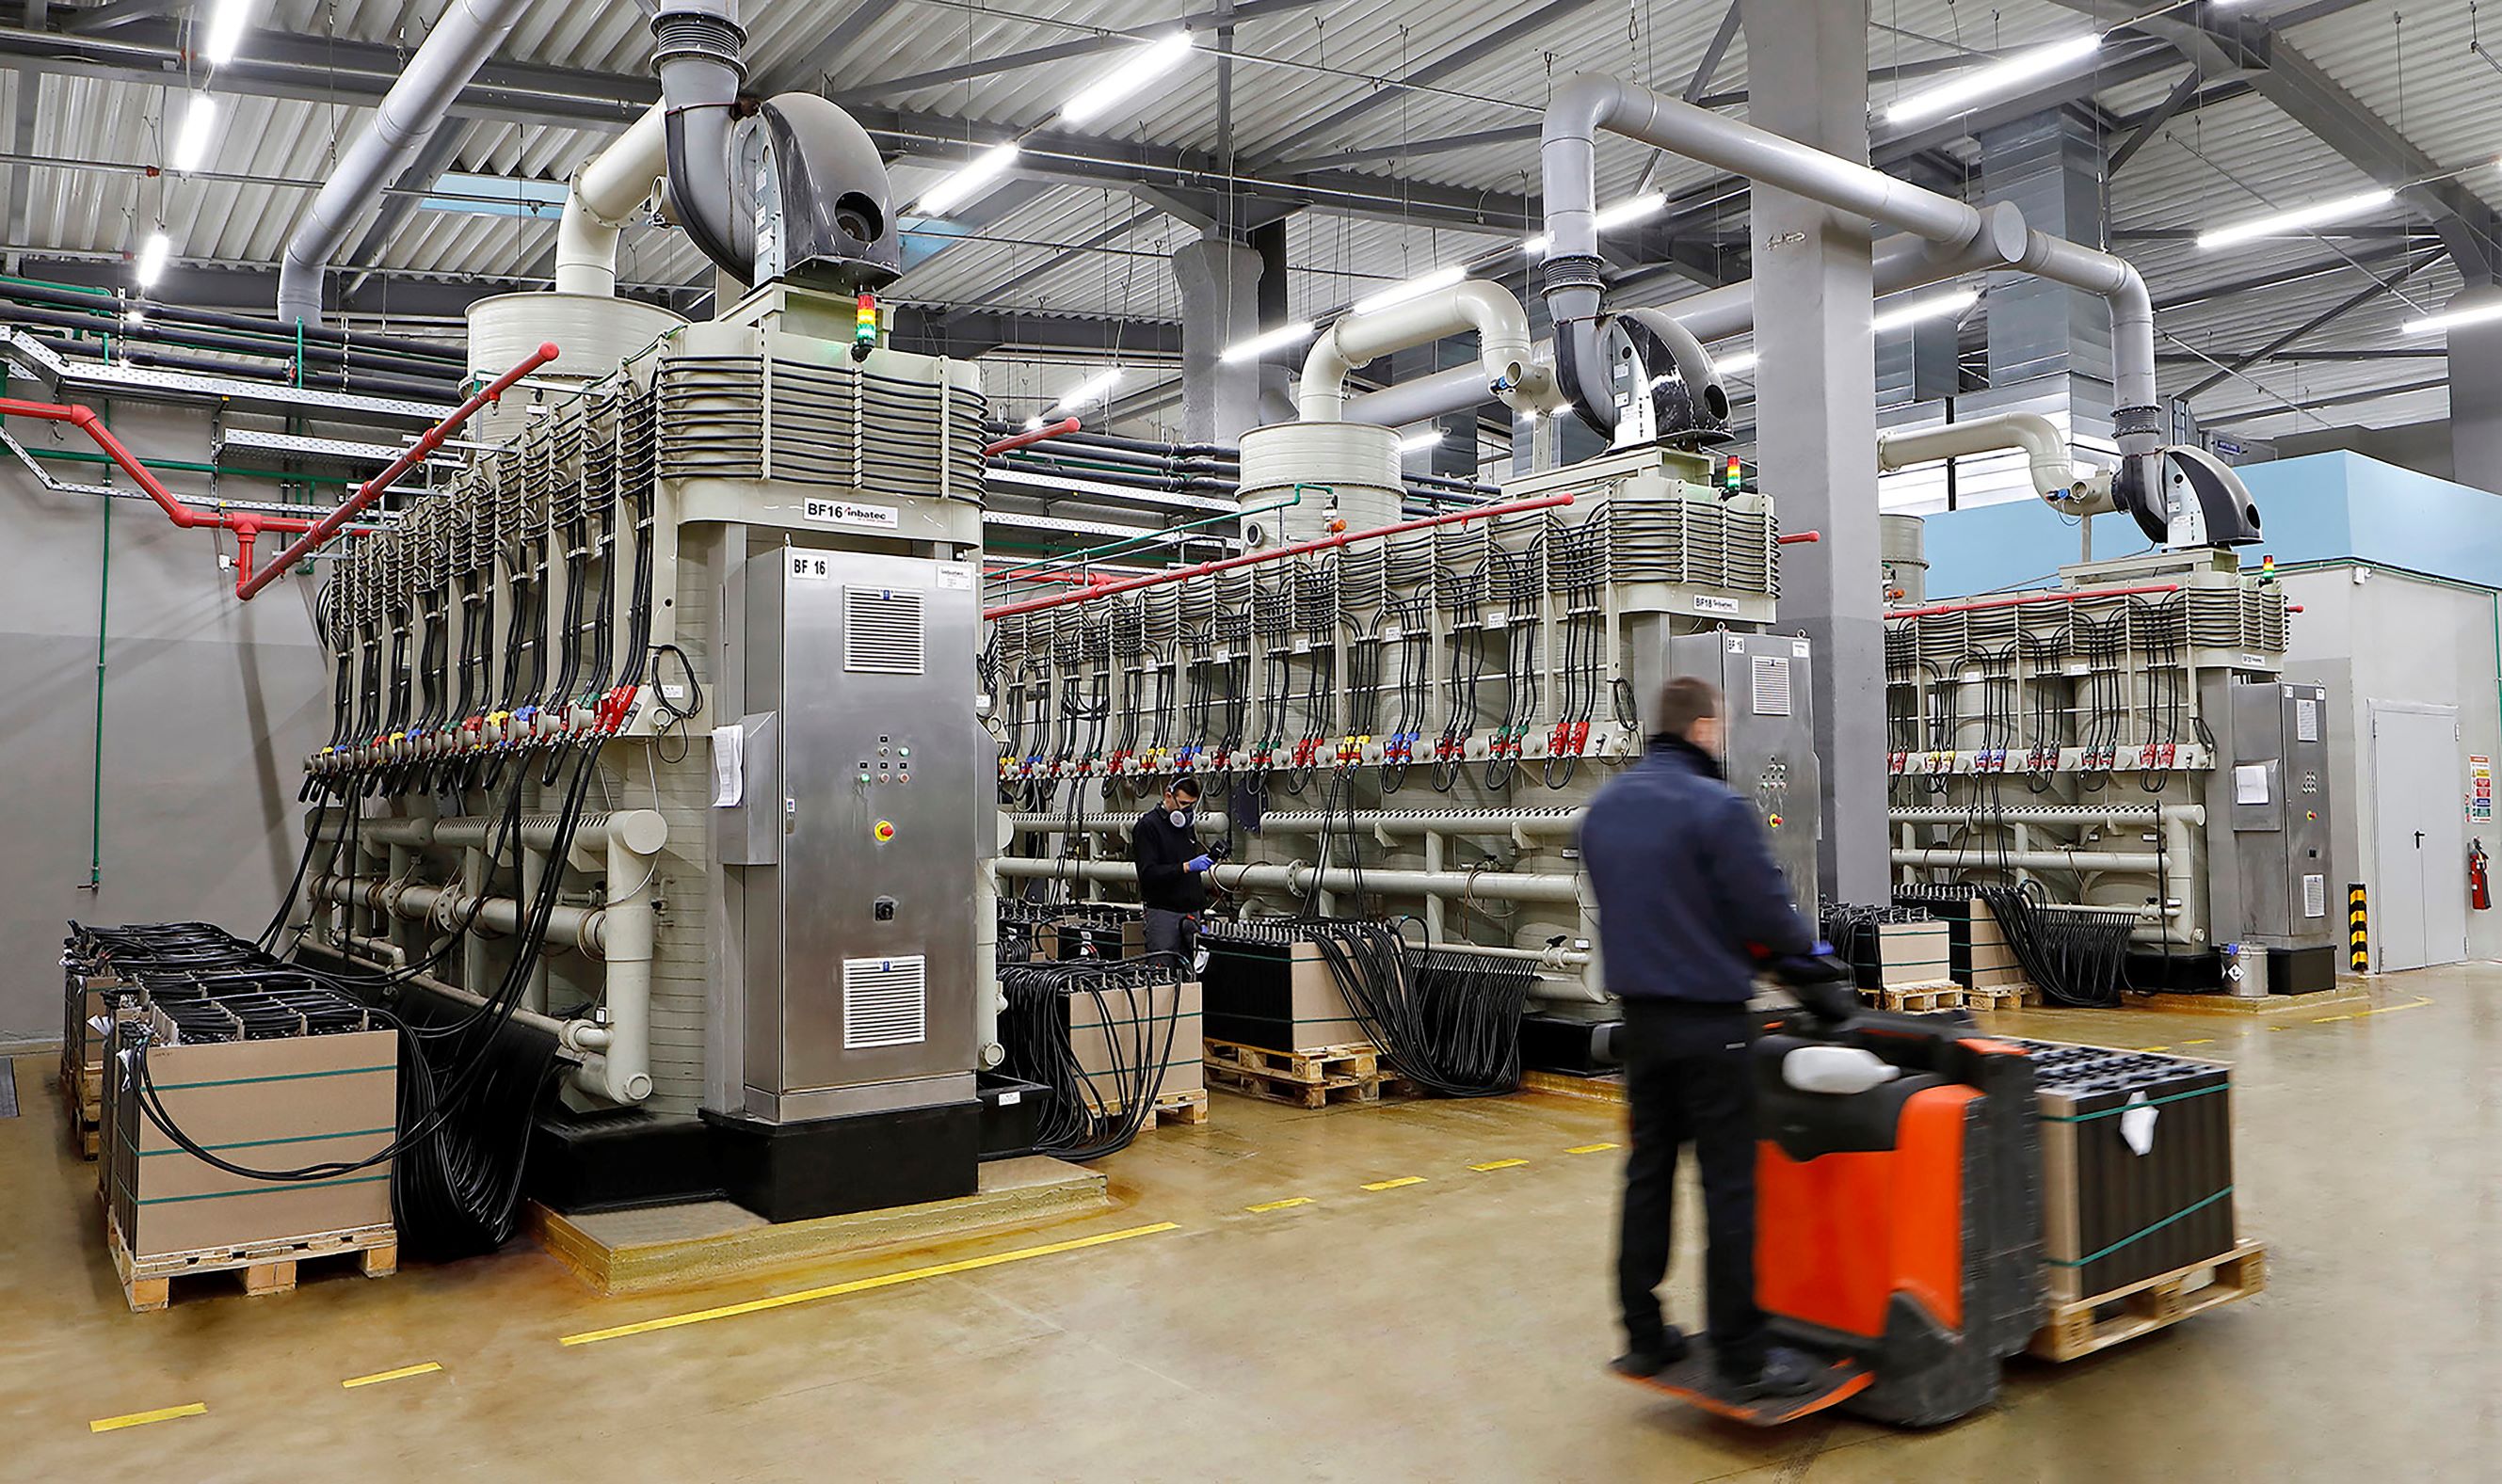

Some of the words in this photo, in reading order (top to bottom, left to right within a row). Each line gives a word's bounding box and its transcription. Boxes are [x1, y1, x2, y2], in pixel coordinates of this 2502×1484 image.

[808, 503, 843, 519] BF16
[844, 507, 886, 519] inbatec
[794, 558, 809, 574] BF
[814, 560, 826, 575] 16
